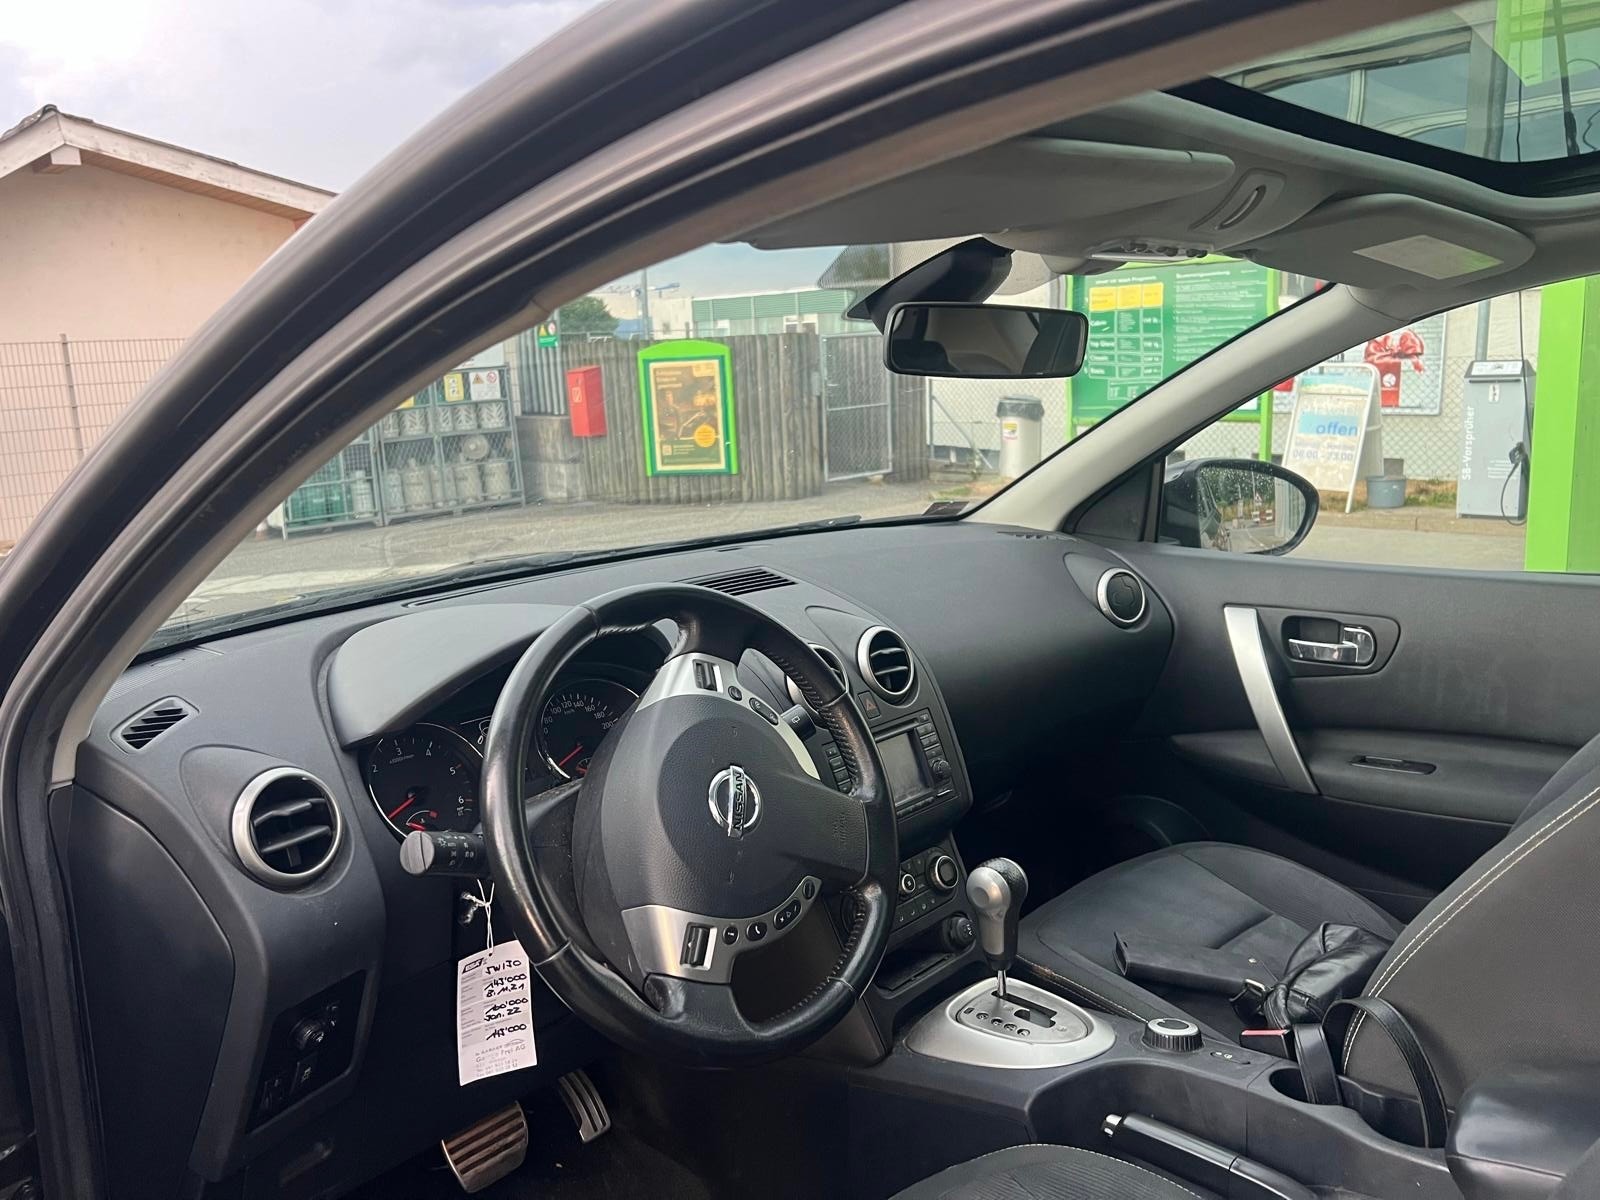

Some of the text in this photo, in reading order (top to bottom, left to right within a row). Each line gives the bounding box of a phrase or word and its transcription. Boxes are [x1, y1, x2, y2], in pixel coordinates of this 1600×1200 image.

[1316, 421, 1358, 436] offen
[1461, 406, 1475, 480] SB-Vorsprüher
[561, 700, 572, 709] 120
[573, 700, 585, 708] 140
[584, 704, 596, 712] 160
[593, 711, 606, 720] 180
[602, 720, 614, 730] 200
[395, 747, 402, 756] 3
[425, 748, 432, 757] 4
[372, 764, 378, 773] 2
[449, 766, 456, 775] 5
[458, 795, 464, 804] 6
[733, 771, 746, 831] NISSAN
